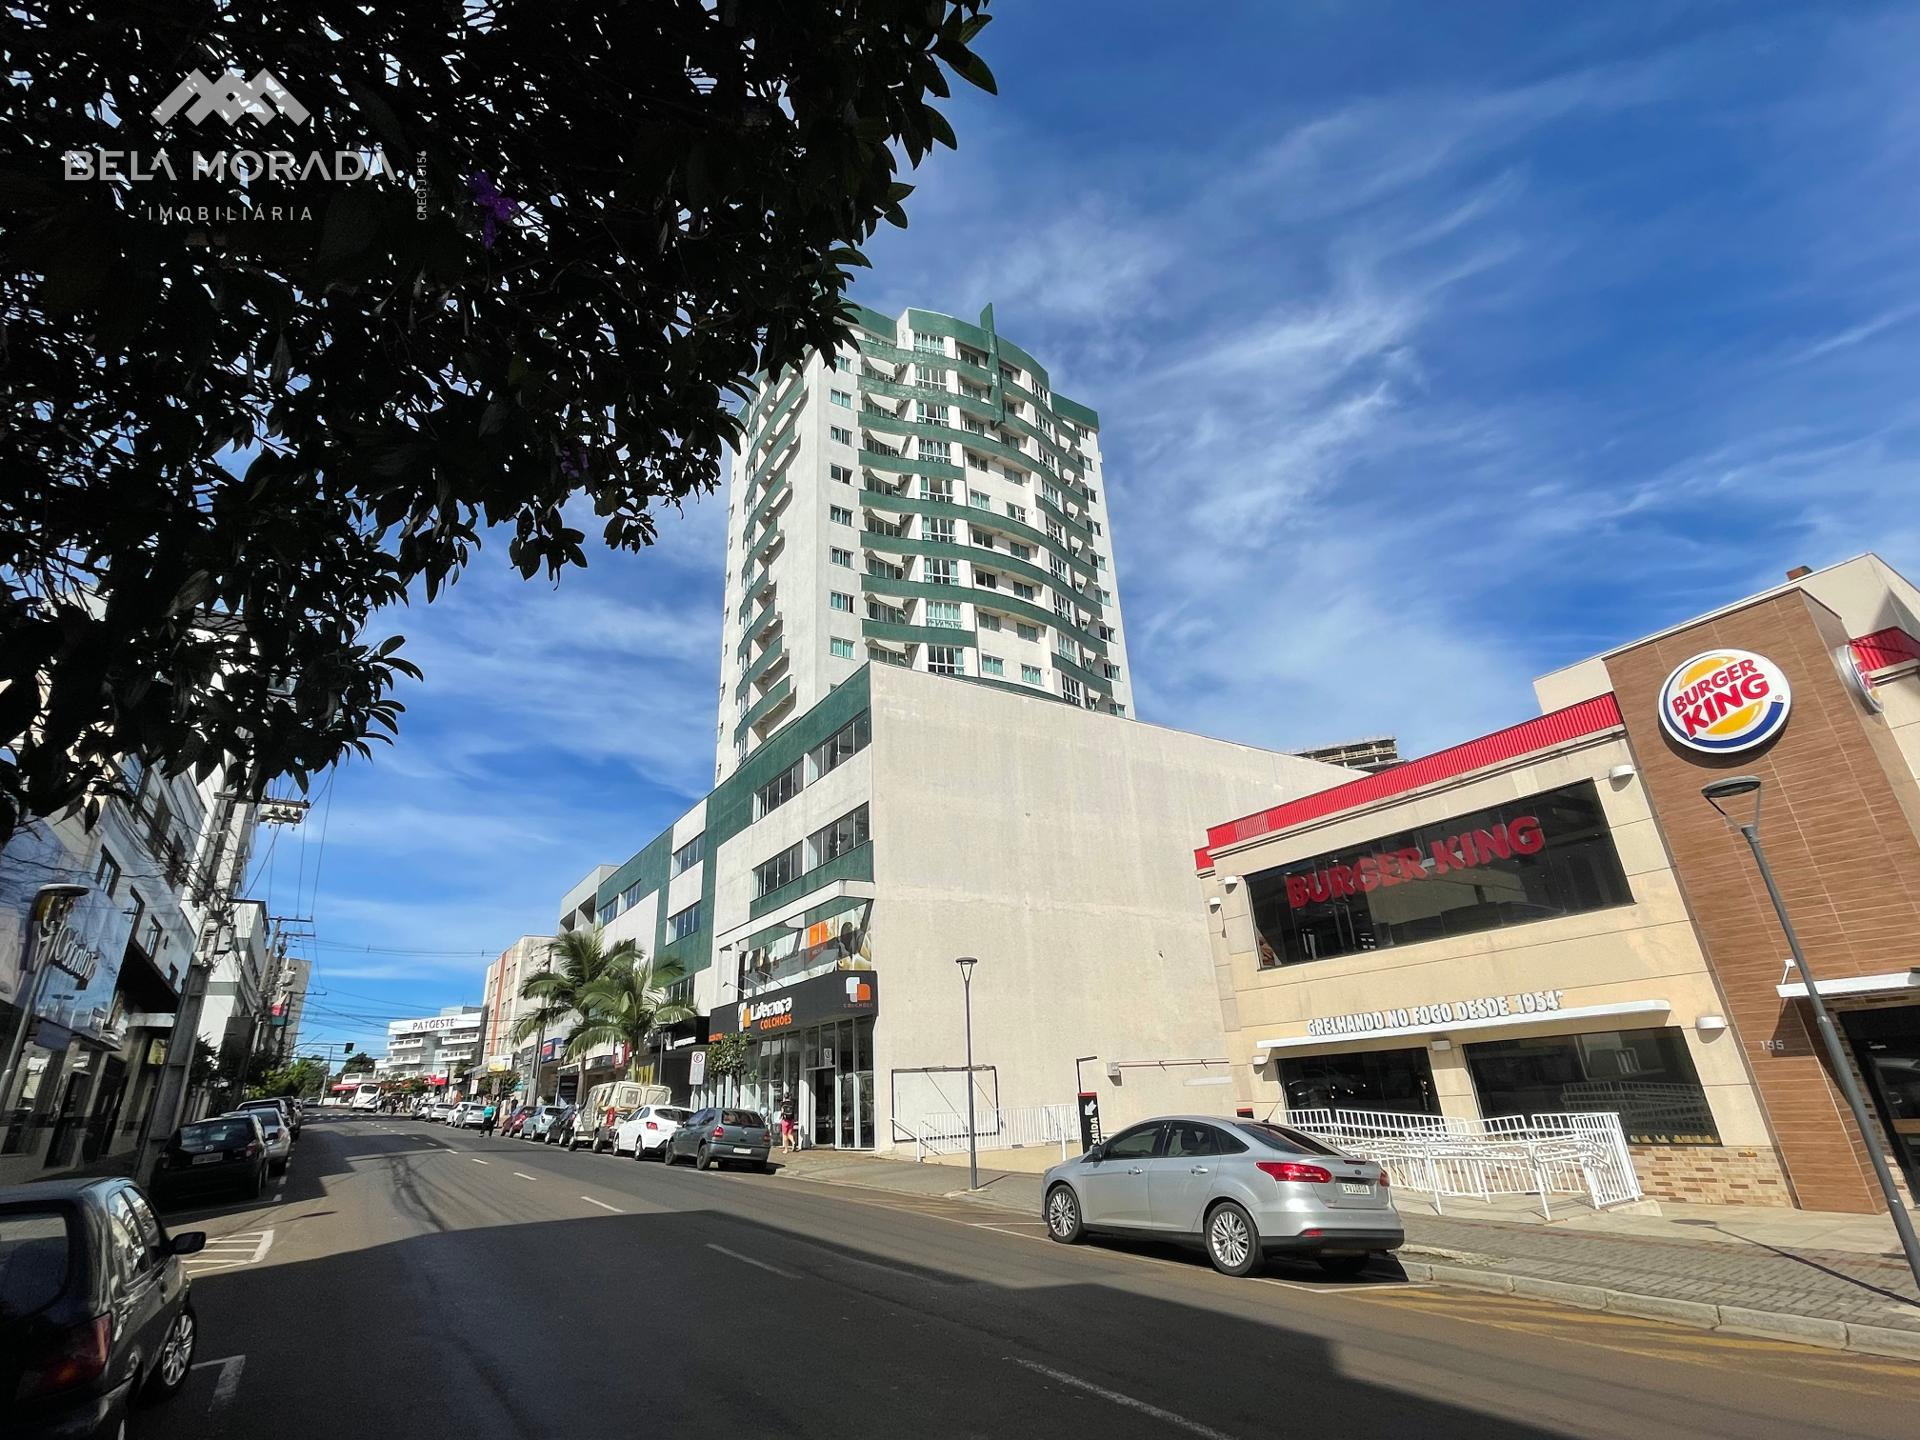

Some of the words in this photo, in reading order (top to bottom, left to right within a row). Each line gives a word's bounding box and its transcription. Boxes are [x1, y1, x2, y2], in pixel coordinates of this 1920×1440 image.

[1672, 659, 1758, 717] BURGER
[1682, 673, 1770, 738] KING
[1285, 847, 1428, 909] BURGER
[1430, 815, 1545, 875] KING
[412, 1018, 455, 1031] PATOESTE
[1307, 1011, 1384, 1036] GRELHANDO
[1386, 1009, 1409, 1029] NO
[1413, 1003, 1452, 1026] FOGO
[1456, 996, 1509, 1022] DESDE
[1760, 1040, 1785, 1050] 195
